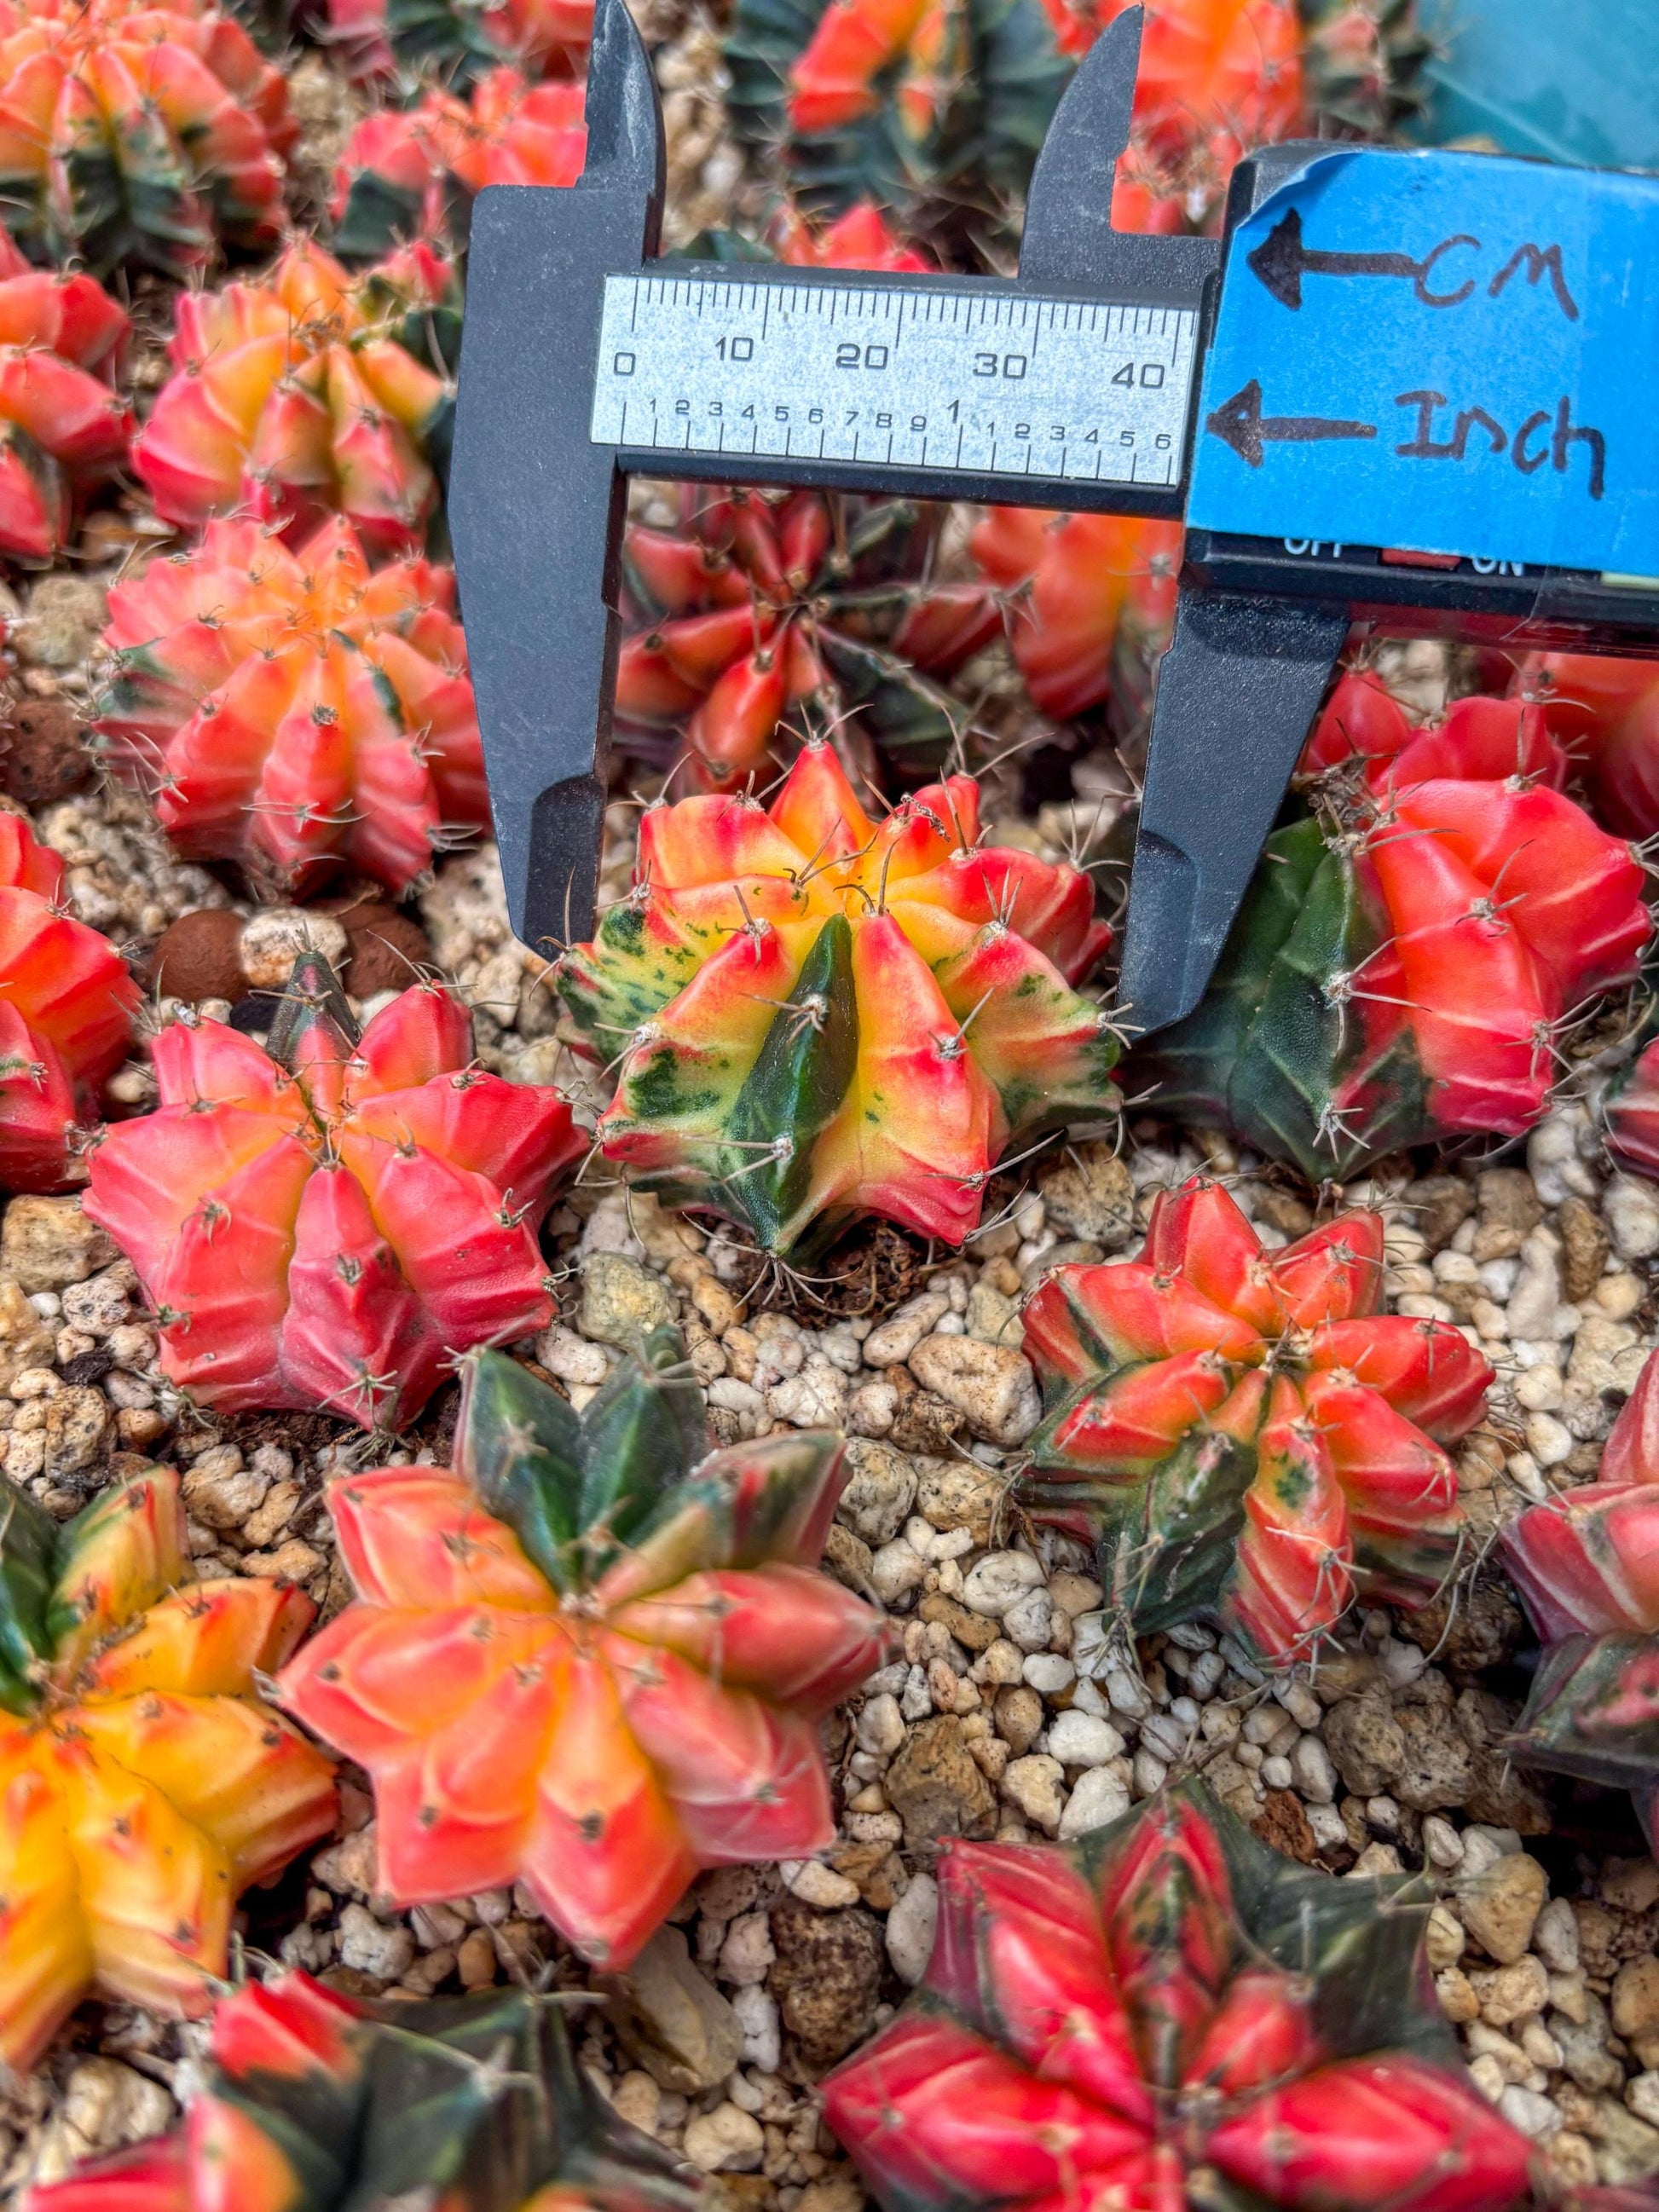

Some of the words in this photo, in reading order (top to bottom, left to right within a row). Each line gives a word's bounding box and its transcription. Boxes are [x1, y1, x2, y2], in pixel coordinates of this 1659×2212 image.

[614, 352, 636, 376] 0
[714, 336, 754, 361] 10
[835, 343, 888, 370] 20
[972, 352, 1027, 380] 30
[1111, 362, 1165, 390] 40
[675, 400, 690, 415] 2
[708, 401, 724, 417] 3
[742, 404, 754, 420] 4
[775, 406, 789, 421] 5
[809, 408, 824, 424] 6
[846, 411, 859, 426] 7
[876, 413, 893, 428] 8
[910, 415, 927, 431] 9
[946, 399, 960, 424] 1
[1014, 424, 1031, 439] 2
[1049, 425, 1066, 441] 3
[1084, 429, 1098, 445] 4
[1119, 430, 1135, 447] 5
[1154, 434, 1171, 449] 6
[1396, 390, 1604, 500] Inch
